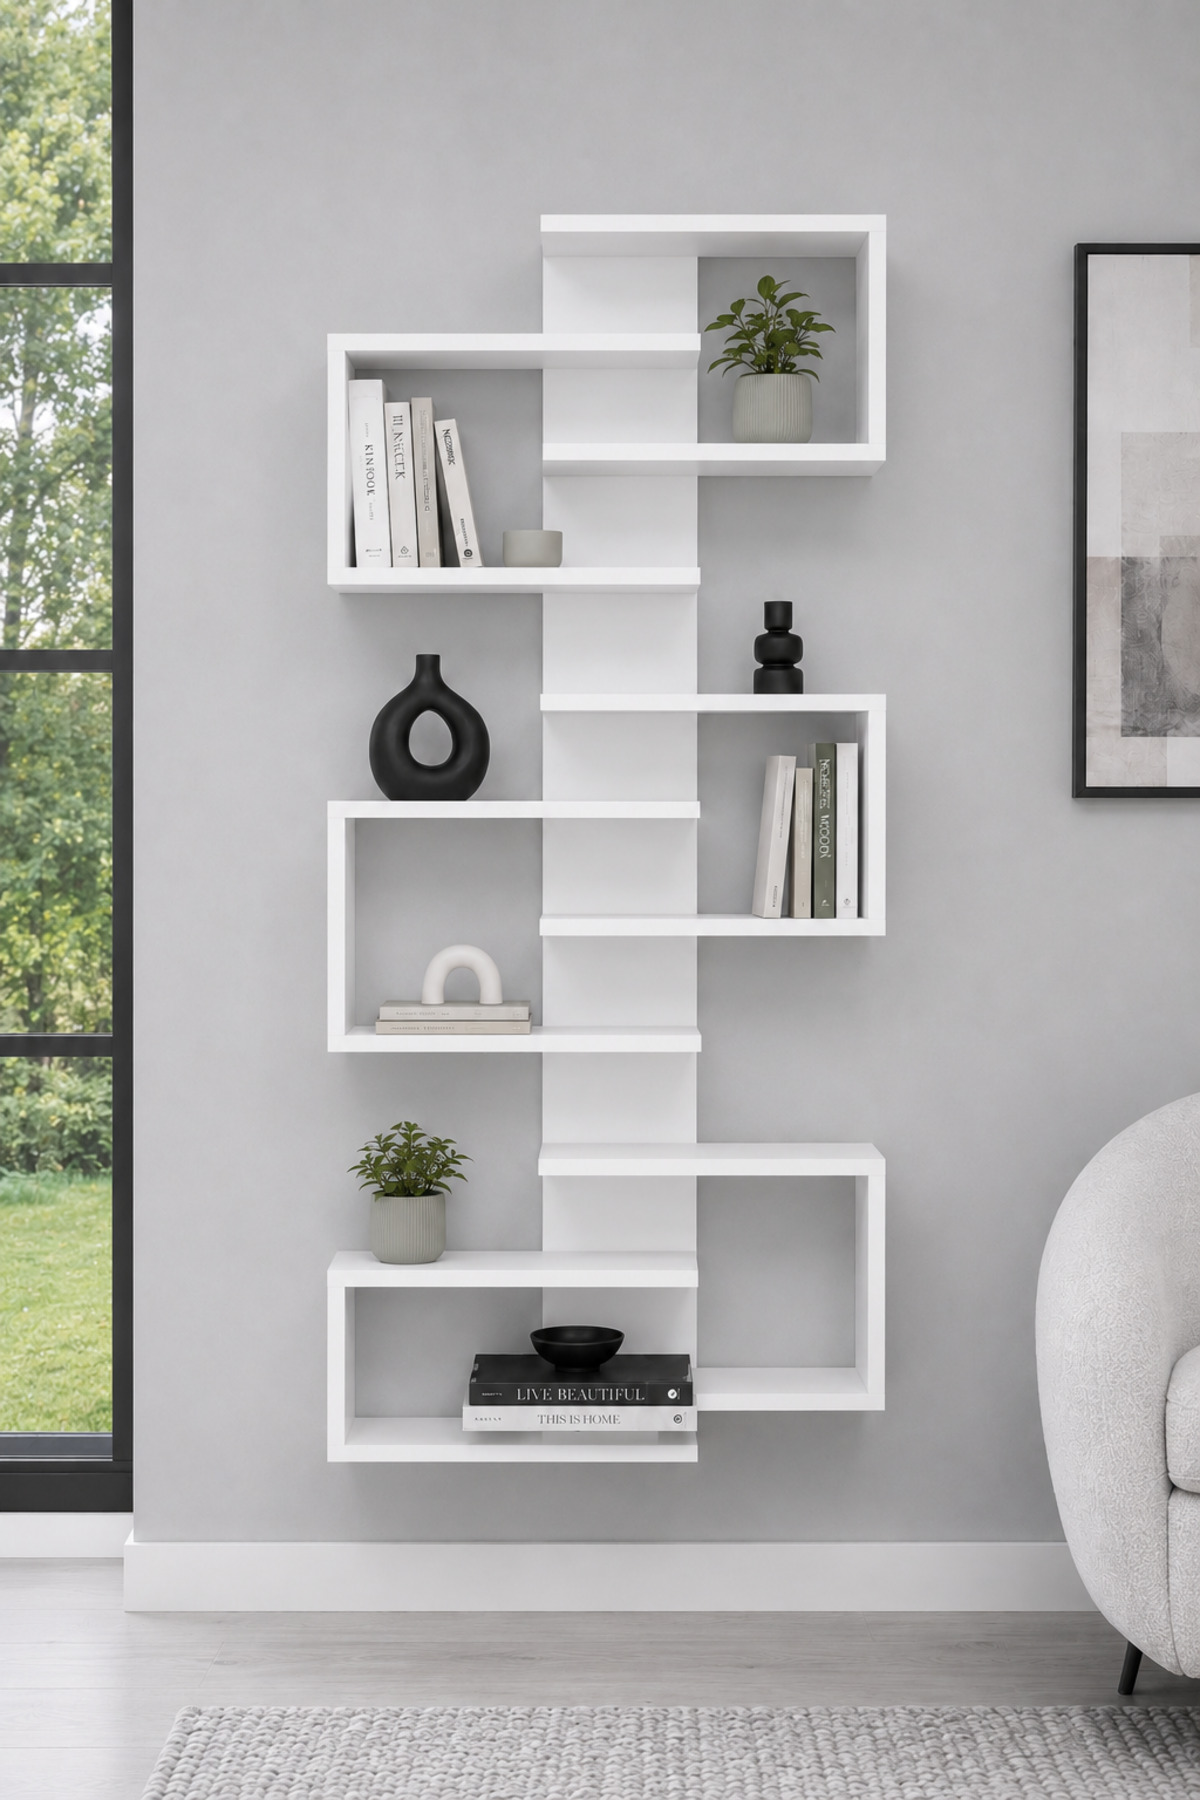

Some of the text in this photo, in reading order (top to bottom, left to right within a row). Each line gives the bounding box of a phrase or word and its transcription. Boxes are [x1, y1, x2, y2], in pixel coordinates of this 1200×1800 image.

[517, 1388, 552, 1401] LIVE
[558, 1388, 645, 1401] BEAUTIFUL
[538, 1414, 621, 1425] THIS IS HOME
